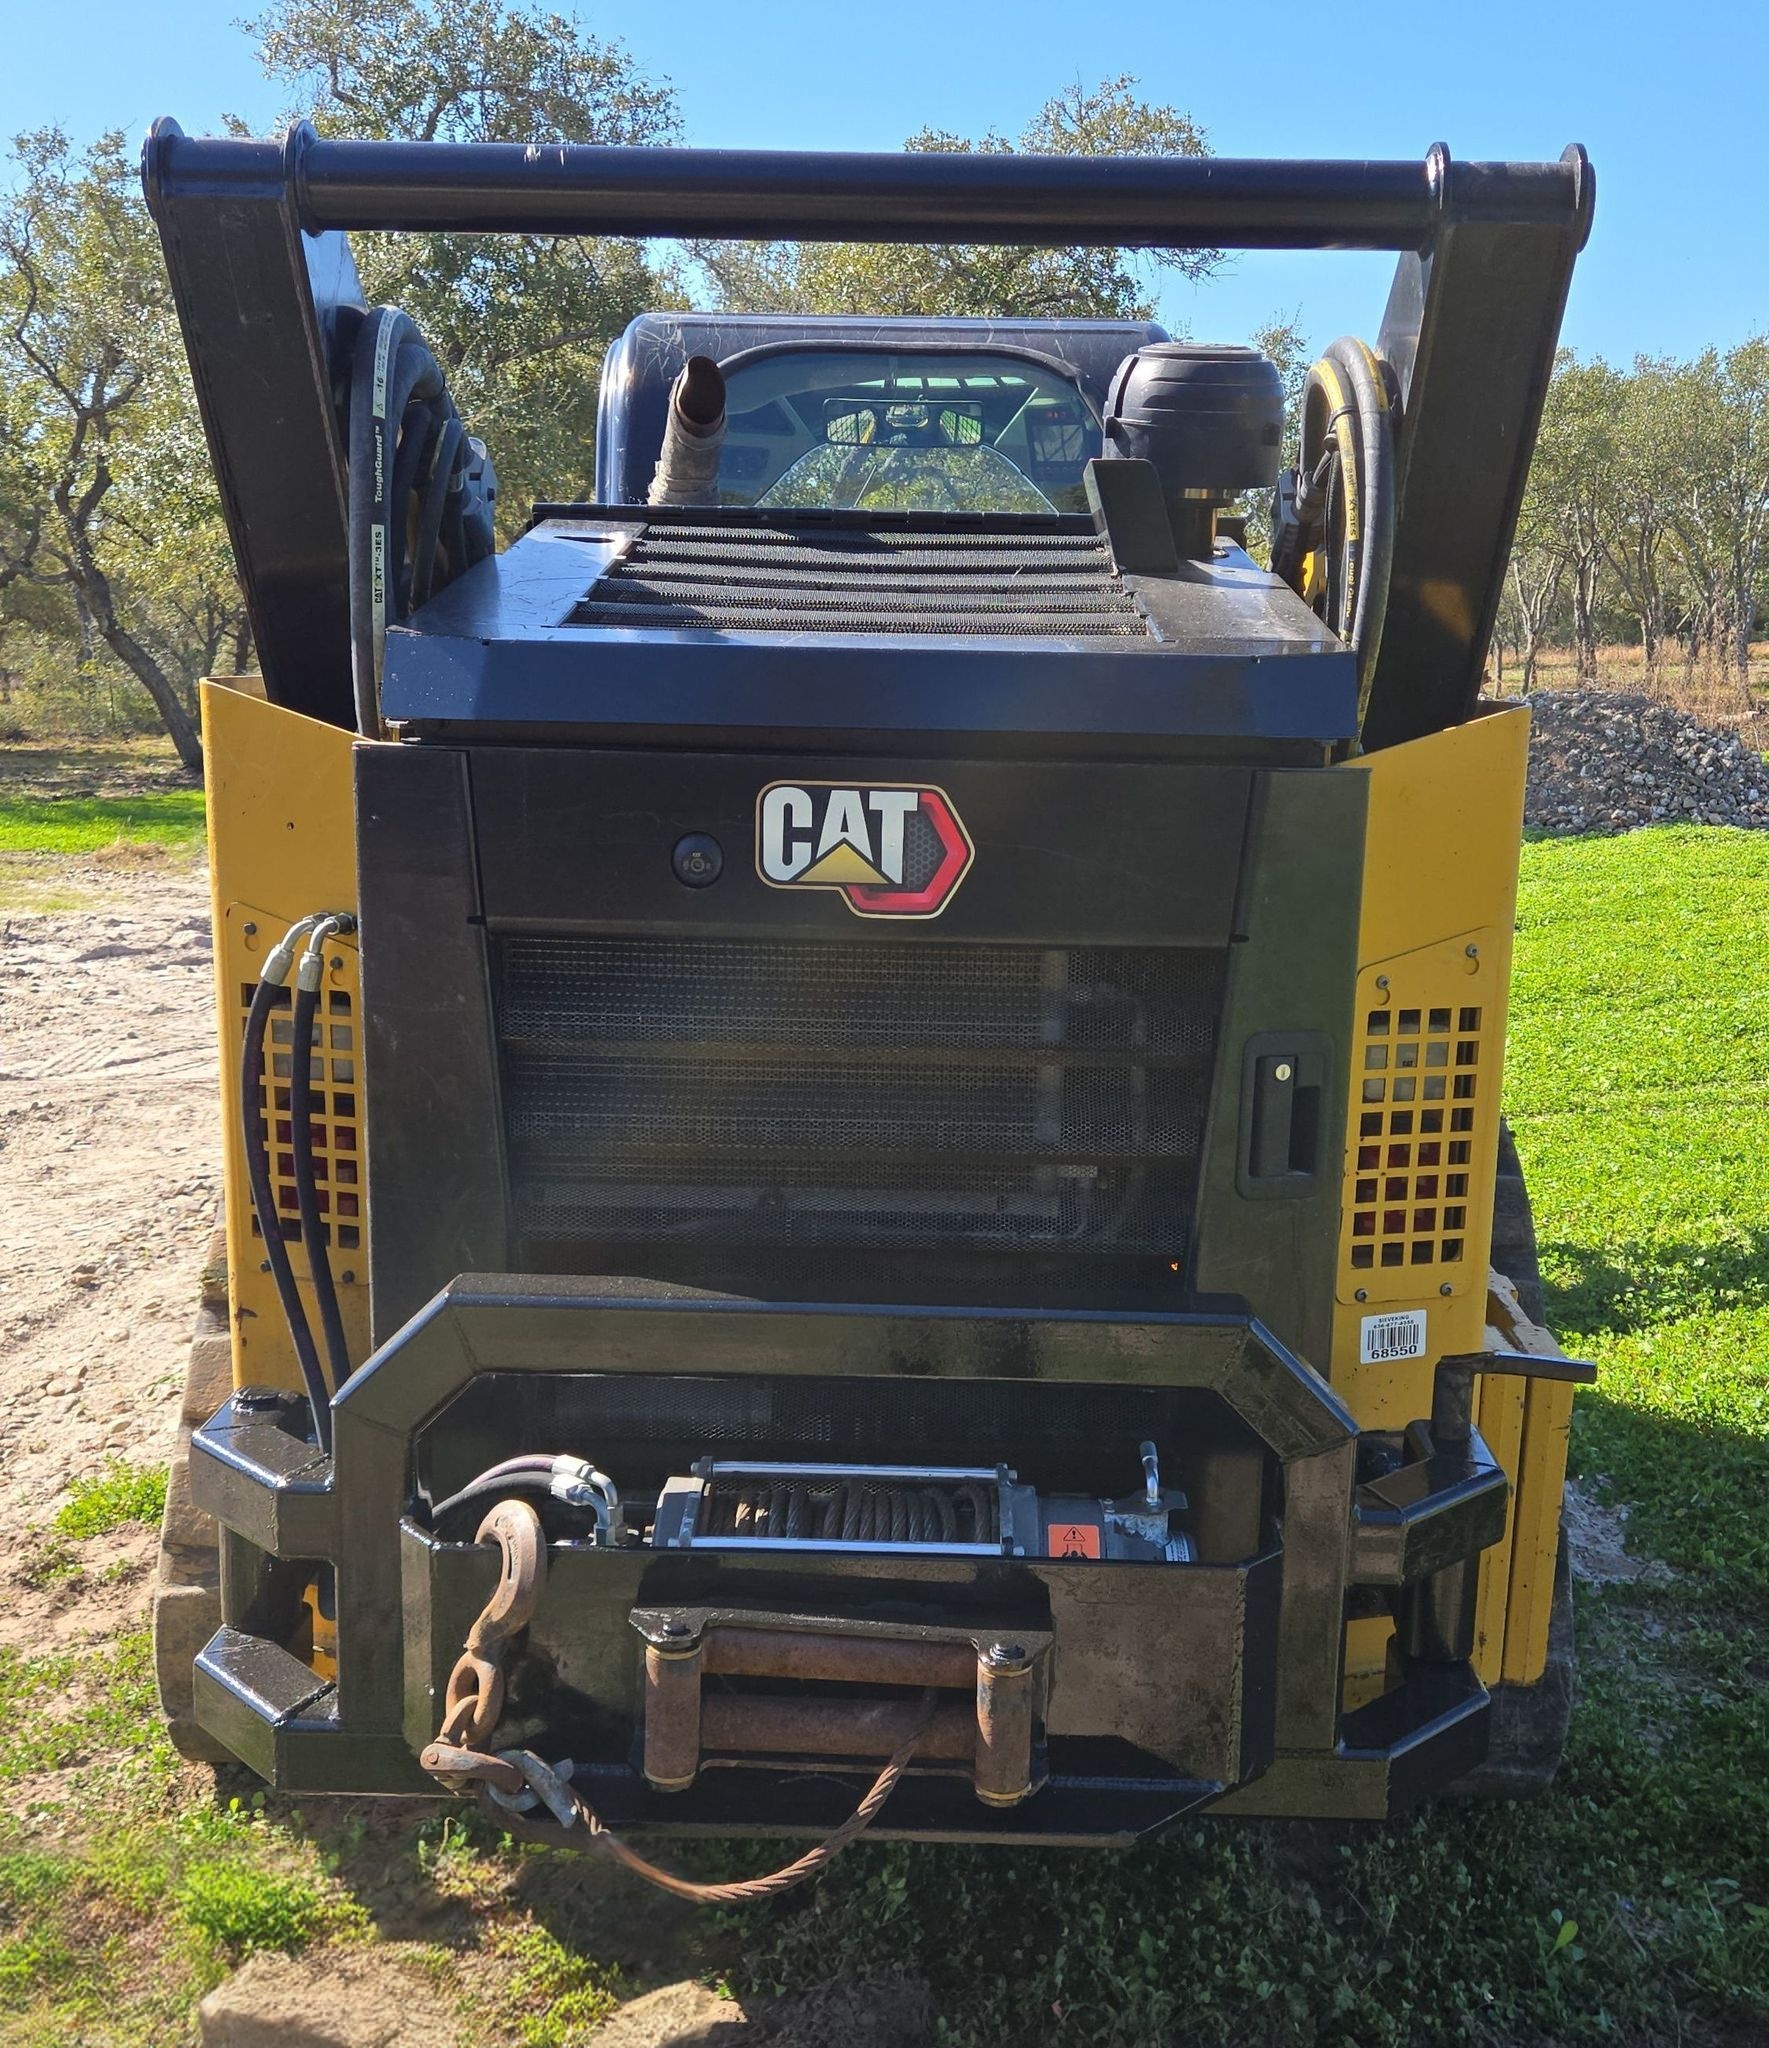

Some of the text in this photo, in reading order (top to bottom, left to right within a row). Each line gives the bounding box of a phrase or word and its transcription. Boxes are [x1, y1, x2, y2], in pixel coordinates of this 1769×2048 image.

[374, 587, 383, 604] CAT
[763, 786, 918, 884] CAT
[1371, 1345, 1417, 1359] 68550
